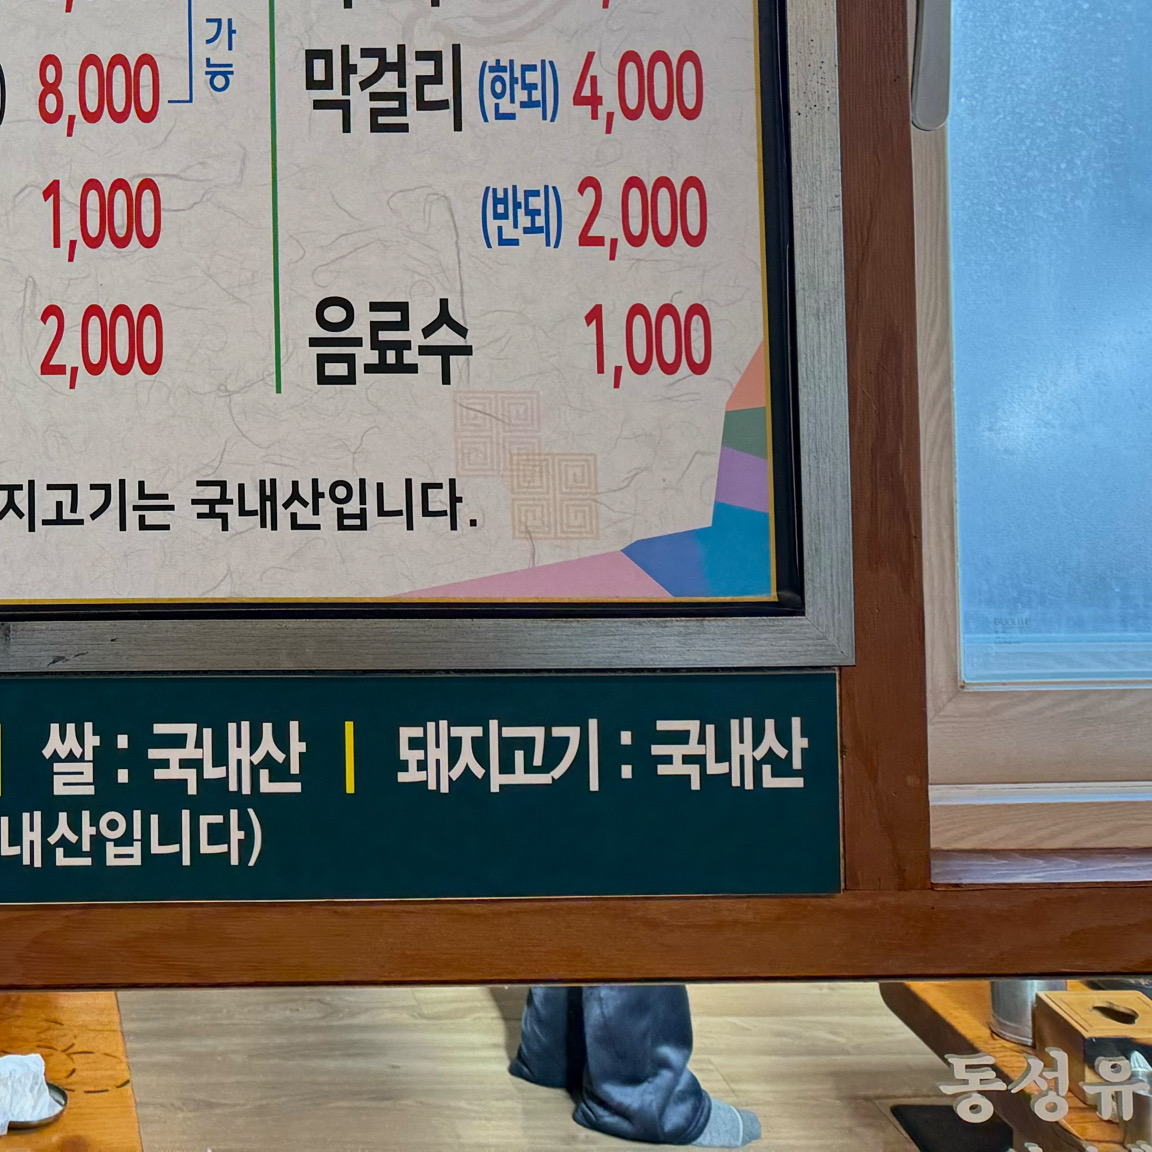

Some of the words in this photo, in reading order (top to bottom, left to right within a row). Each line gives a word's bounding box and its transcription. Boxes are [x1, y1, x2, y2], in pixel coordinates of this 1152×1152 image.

[38, 52, 160, 138] 8,000
[304, 43, 463, 134] 막걸리
[478, 58, 559, 123] (한되)
[572, 49, 704, 135] 4,000
[41, 177, 162, 263] 1,000
[481, 184, 563, 249] (반되)
[577, 175, 708, 261] 2,000
[40, 303, 164, 390] 2,000
[308, 296, 473, 386] 음료수
[584, 302, 712, 389] 1,000
[190, 477, 478, 532] 국내산입니다.
[147, 720, 307, 795] 국내산
[650, 716, 809, 791] 국내산
